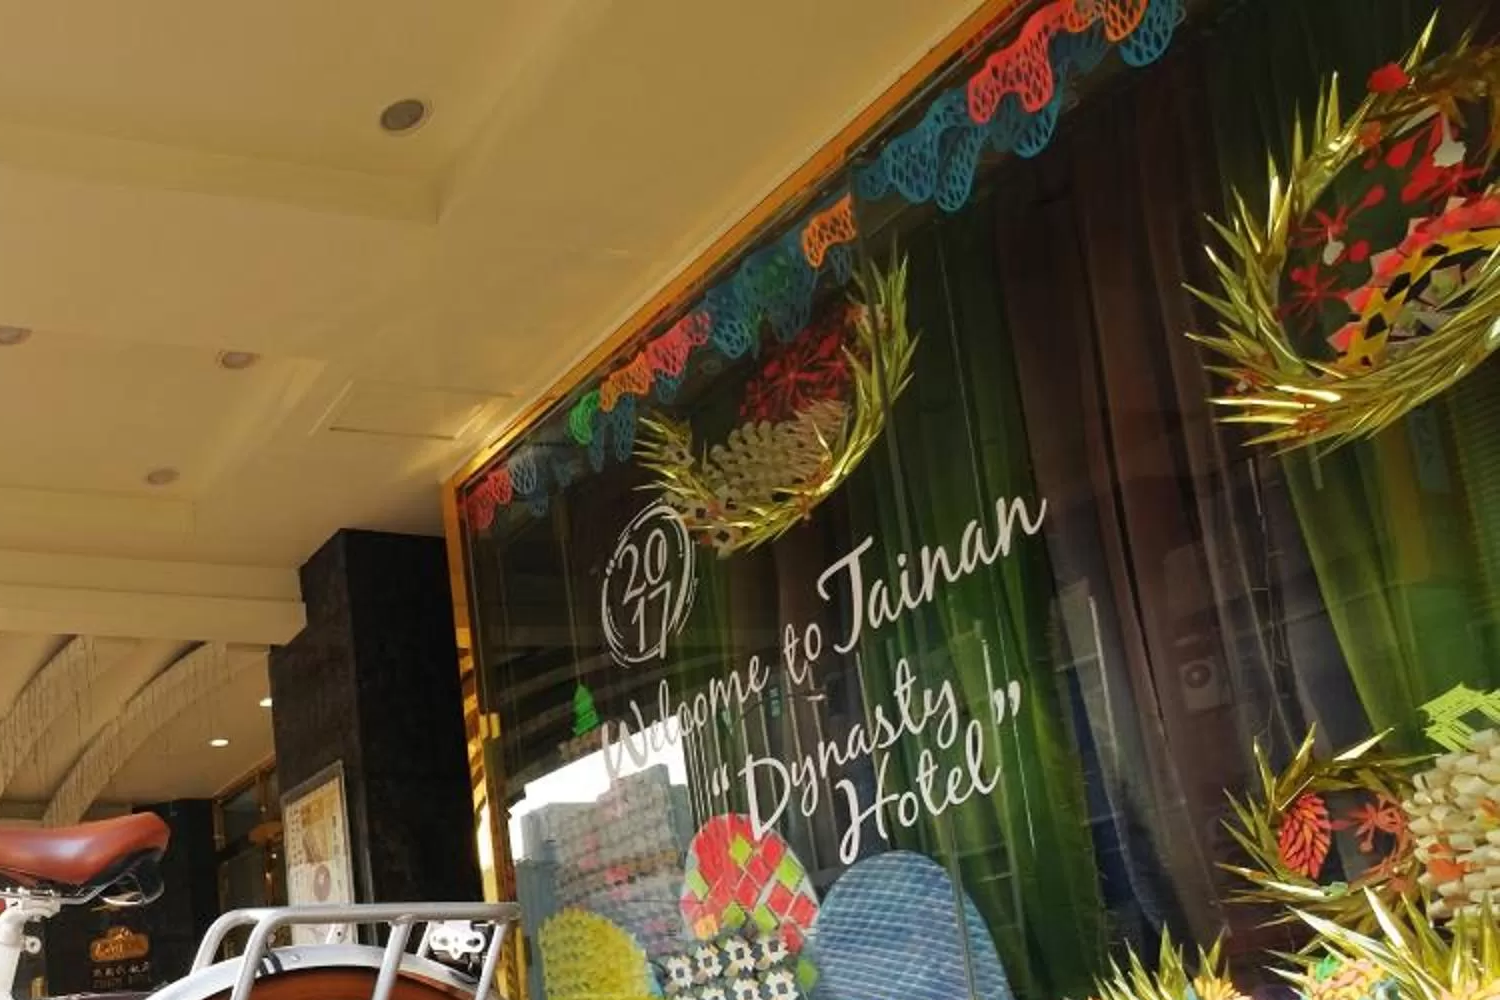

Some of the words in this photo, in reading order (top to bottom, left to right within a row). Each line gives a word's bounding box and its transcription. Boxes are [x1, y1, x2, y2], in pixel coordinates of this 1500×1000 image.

[618, 527, 668, 606] 20
[601, 655, 770, 782] Welcome
[784, 622, 822, 686] to
[816, 496, 1047, 654] Tainan
[631, 579, 673, 659] 17
